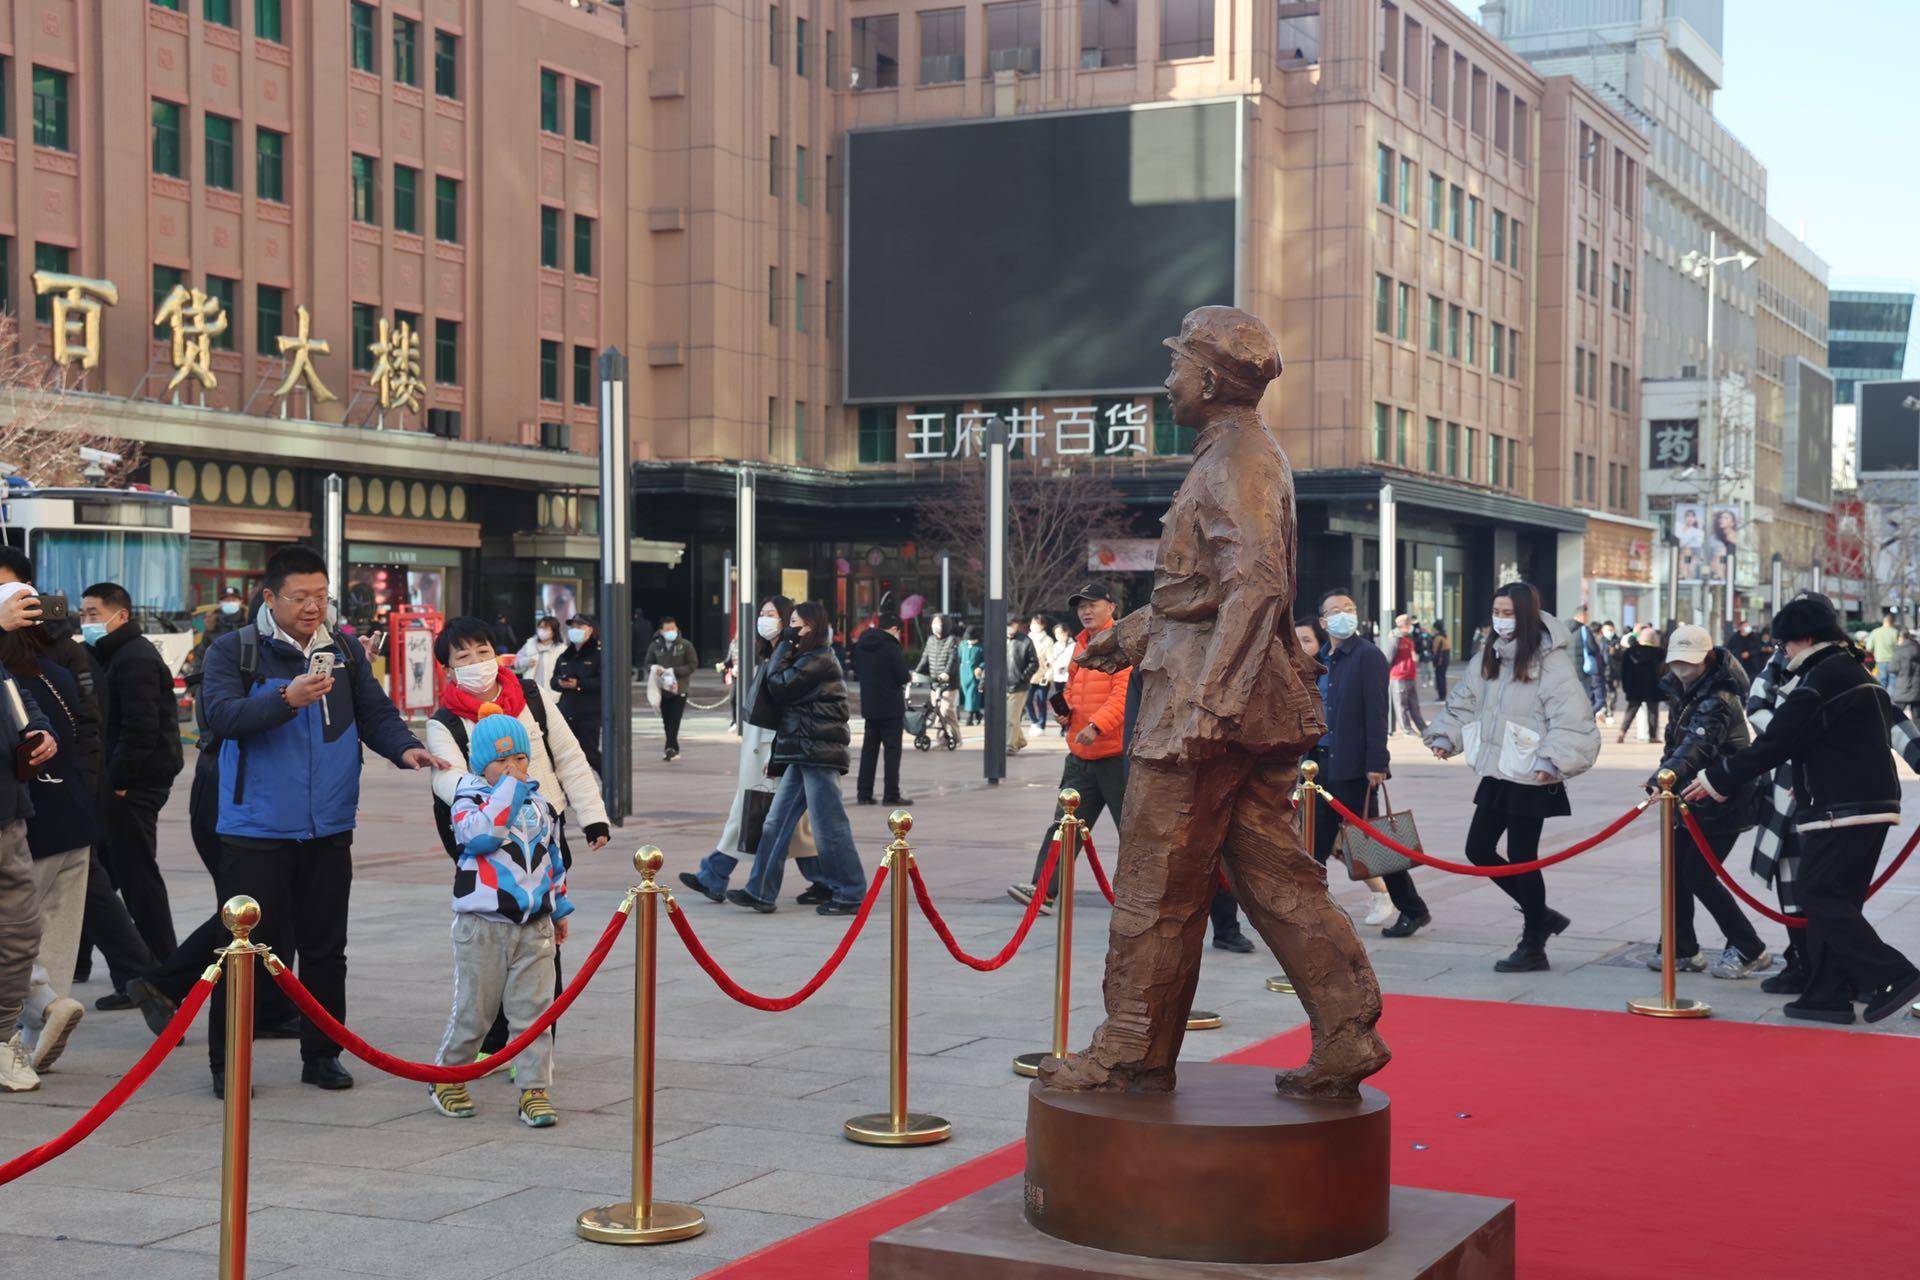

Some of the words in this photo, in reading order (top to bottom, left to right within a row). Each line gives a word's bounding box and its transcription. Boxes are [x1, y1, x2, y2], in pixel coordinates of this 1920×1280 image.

[33, 270, 427, 415] 百货大楼
[904, 403, 1148, 459] 王府井百货
[1656, 427, 1693, 463] 药
